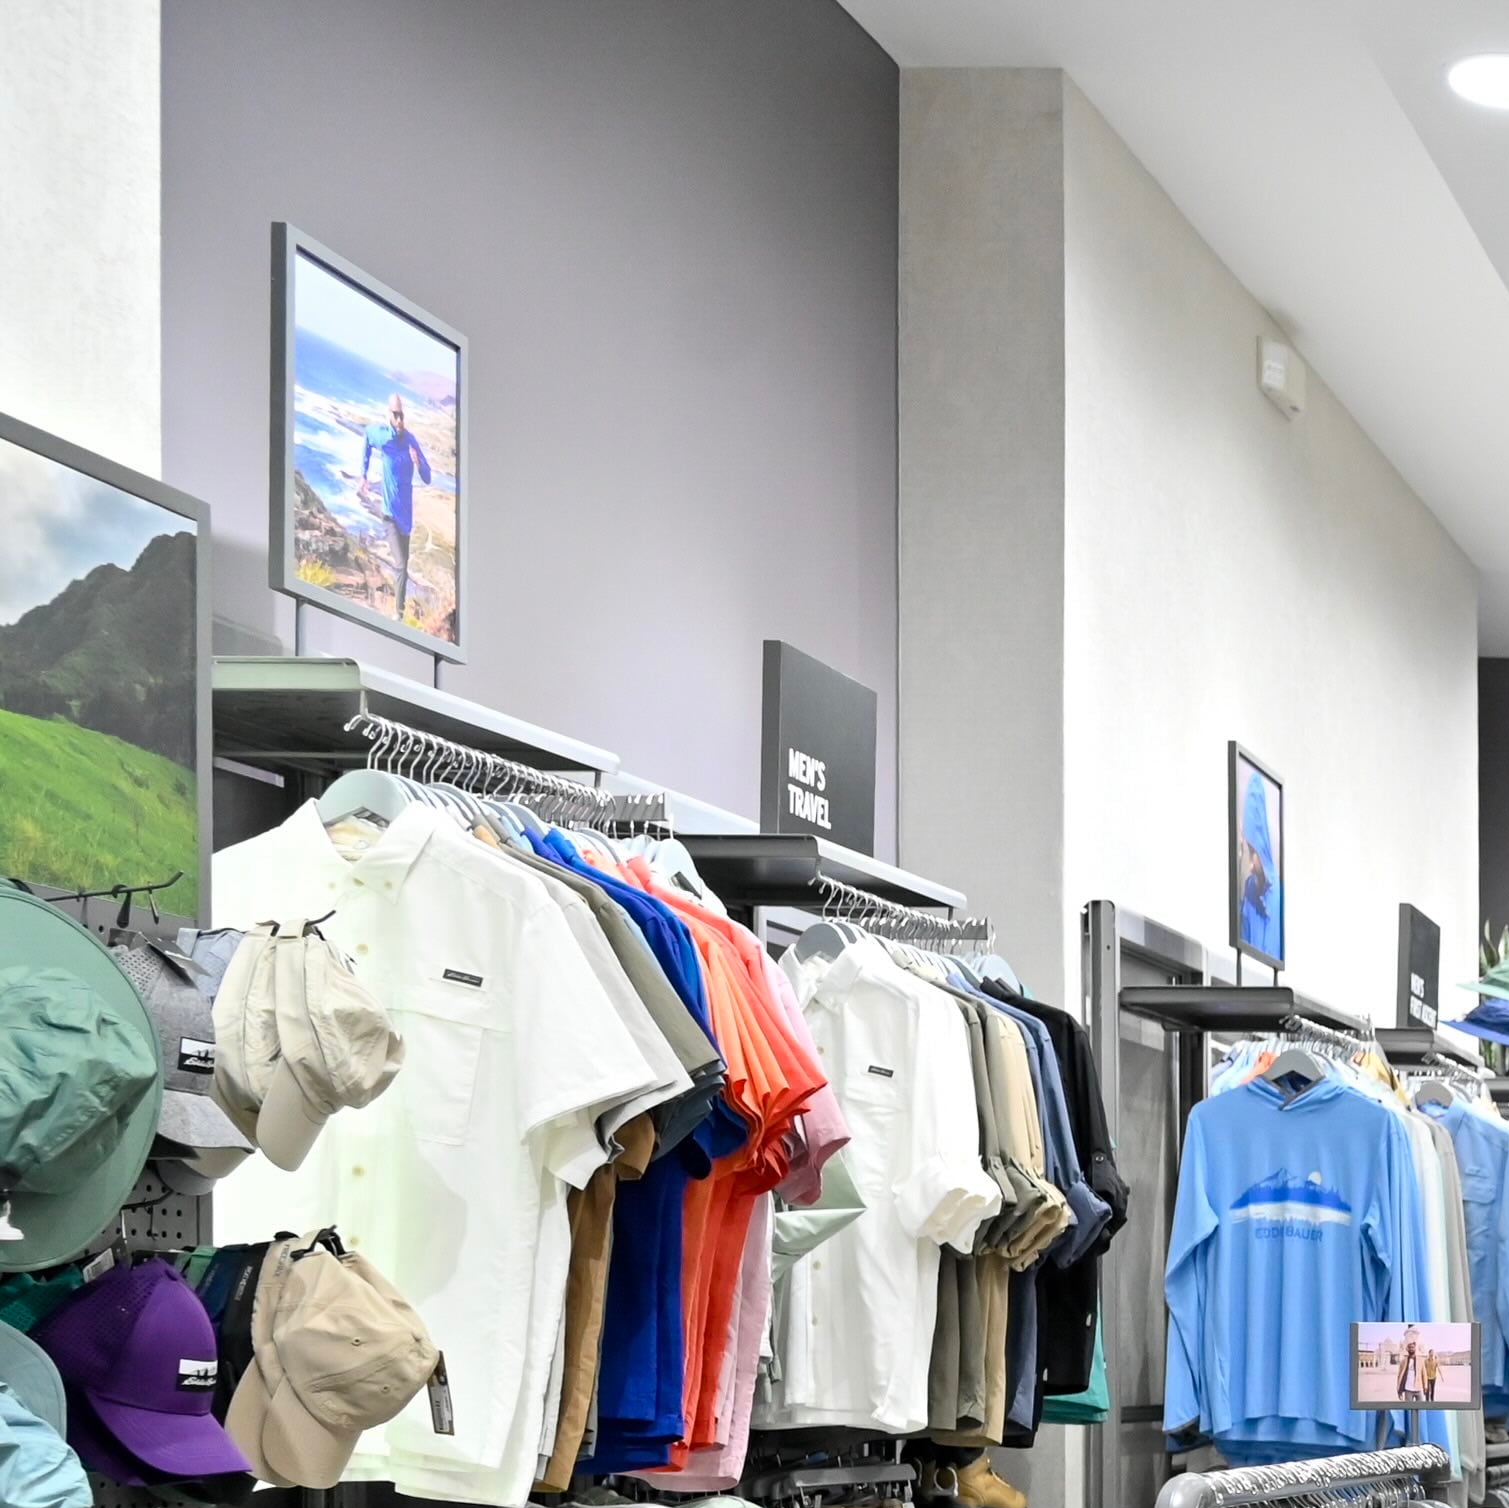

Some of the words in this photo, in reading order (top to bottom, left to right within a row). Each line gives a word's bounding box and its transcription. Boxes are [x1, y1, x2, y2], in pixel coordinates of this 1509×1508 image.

[788, 748, 826, 791] MEN'S
[787, 783, 832, 829] TRAVEL
[1285, 1226, 1323, 1241] BAUER
